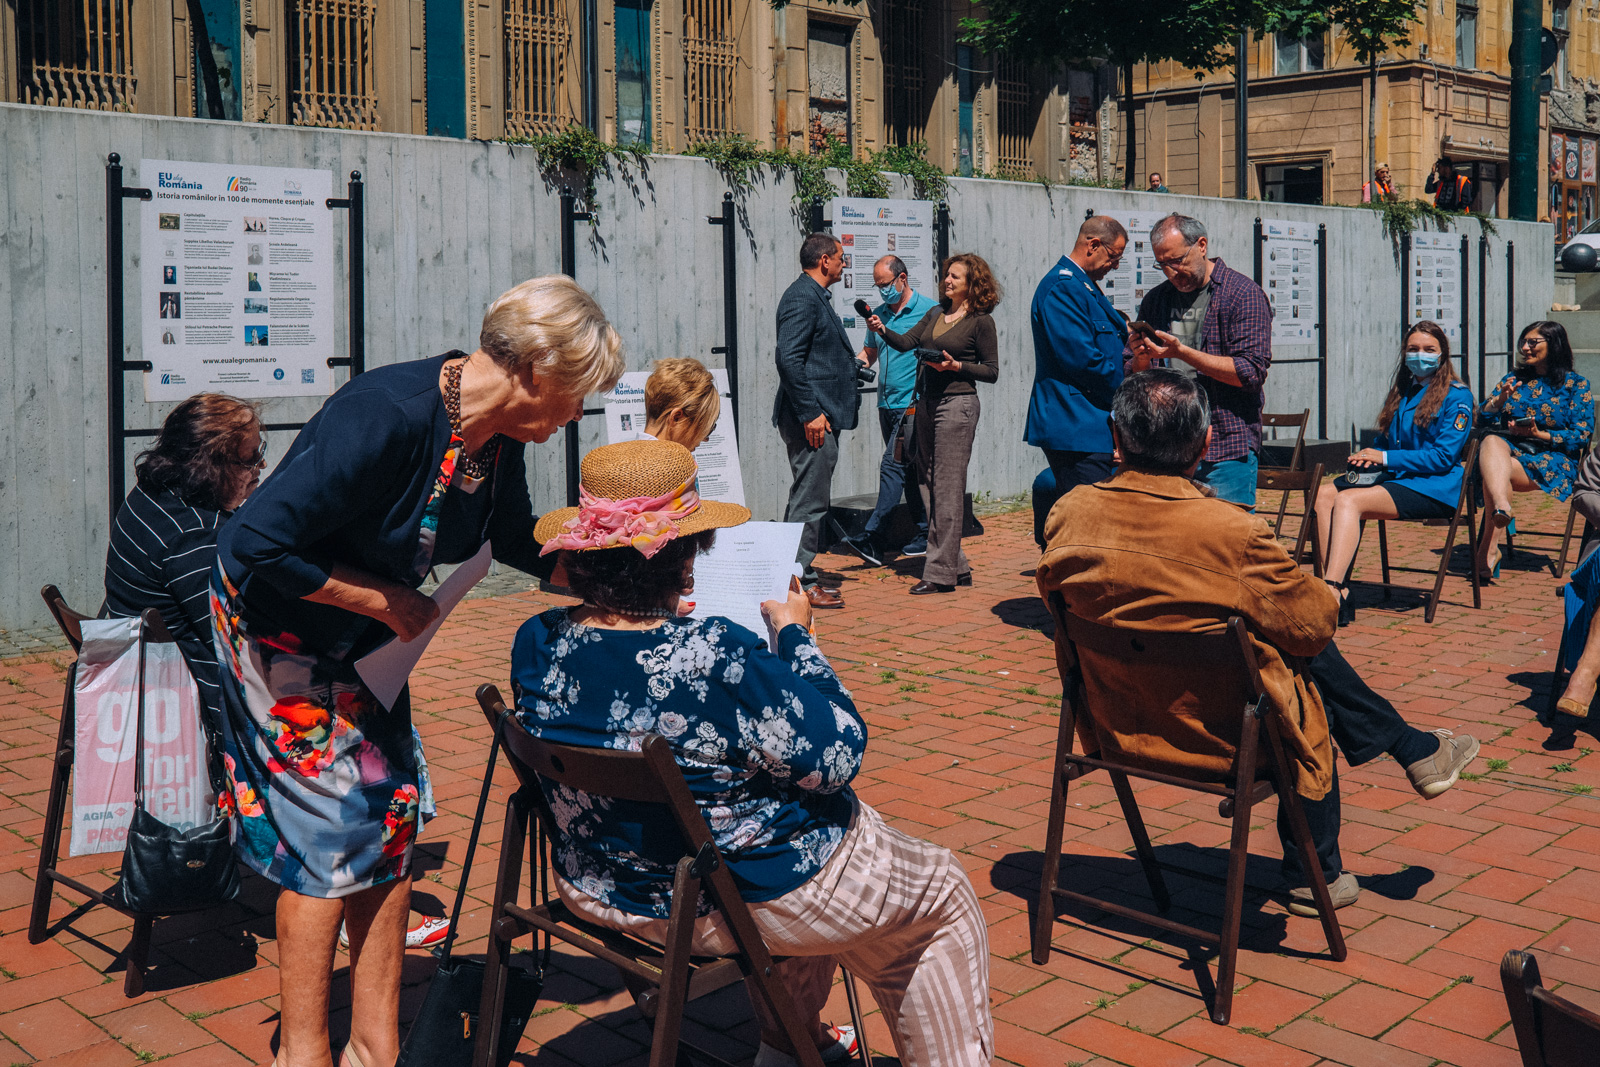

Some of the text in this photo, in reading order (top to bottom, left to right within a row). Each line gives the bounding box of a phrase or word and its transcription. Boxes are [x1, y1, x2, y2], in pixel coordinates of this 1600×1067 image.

[158, 172, 173, 180] EU
[158, 180, 203, 190] România
[157, 192, 180, 200] Istoria
[182, 193, 217, 202] românilor
[241, 195, 250, 203] de
[251, 197, 284, 205] momente
[202, 357, 277, 365] www.eualegromania.ro
[97, 689, 180, 763] go
[143, 748, 190, 786] for
[143, 776, 197, 816] red
[83, 811, 114, 821] AGFA
[87, 827, 129, 844] PRO
